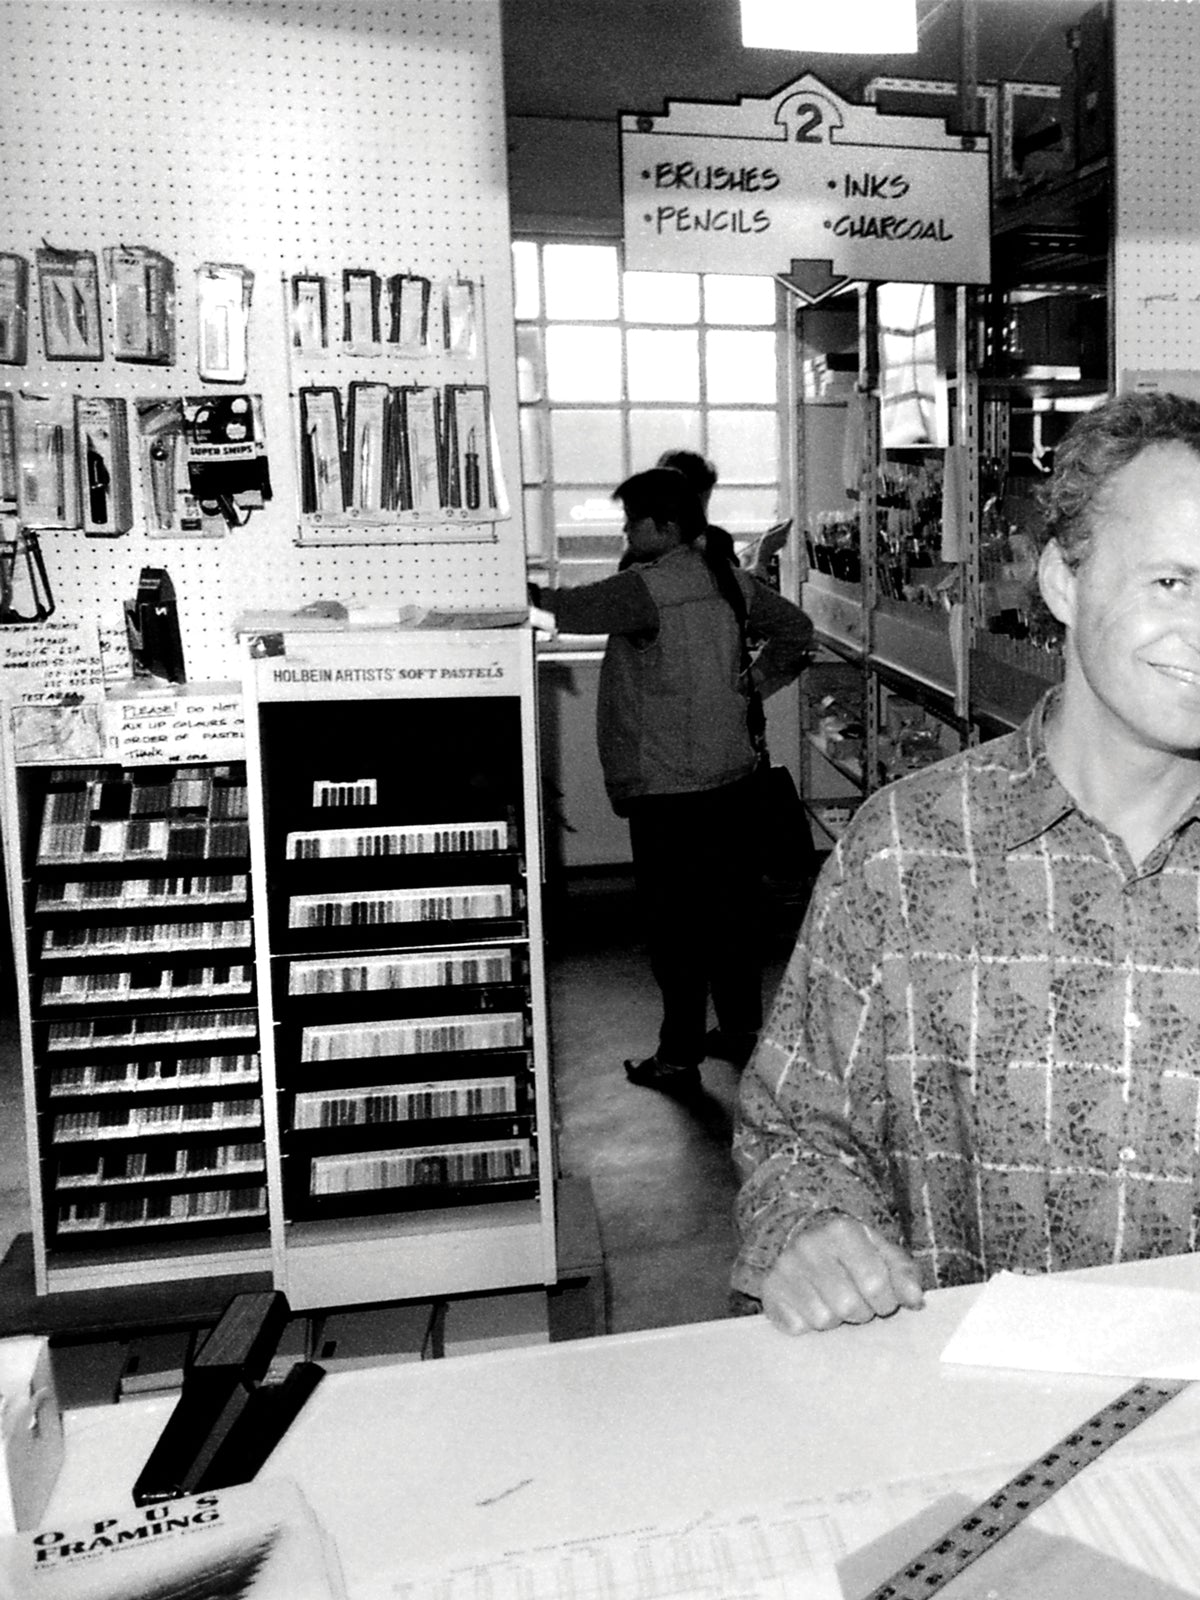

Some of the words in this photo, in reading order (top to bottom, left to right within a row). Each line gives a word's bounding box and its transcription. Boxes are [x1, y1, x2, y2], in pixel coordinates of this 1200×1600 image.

[795, 103, 823, 143] 2
[655, 162, 781, 192] BRUSHES
[844, 174, 910, 199] INKS
[656, 206, 771, 235] PENCILS
[831, 215, 953, 242] CHARCOAL
[190, 447, 221, 456] SUPER
[274, 669, 332, 683] HOLBEIN
[399, 668, 438, 681] SOFT
[441, 666, 504, 680] PASTELS
[186, 705, 205, 714] DO
[212, 702, 239, 712] NOT
[148, 721, 167, 729] UP
[123, 735, 168, 744] ORDER
[174, 733, 189, 741] OF
[36, 1508, 220, 1562] FRAMING
